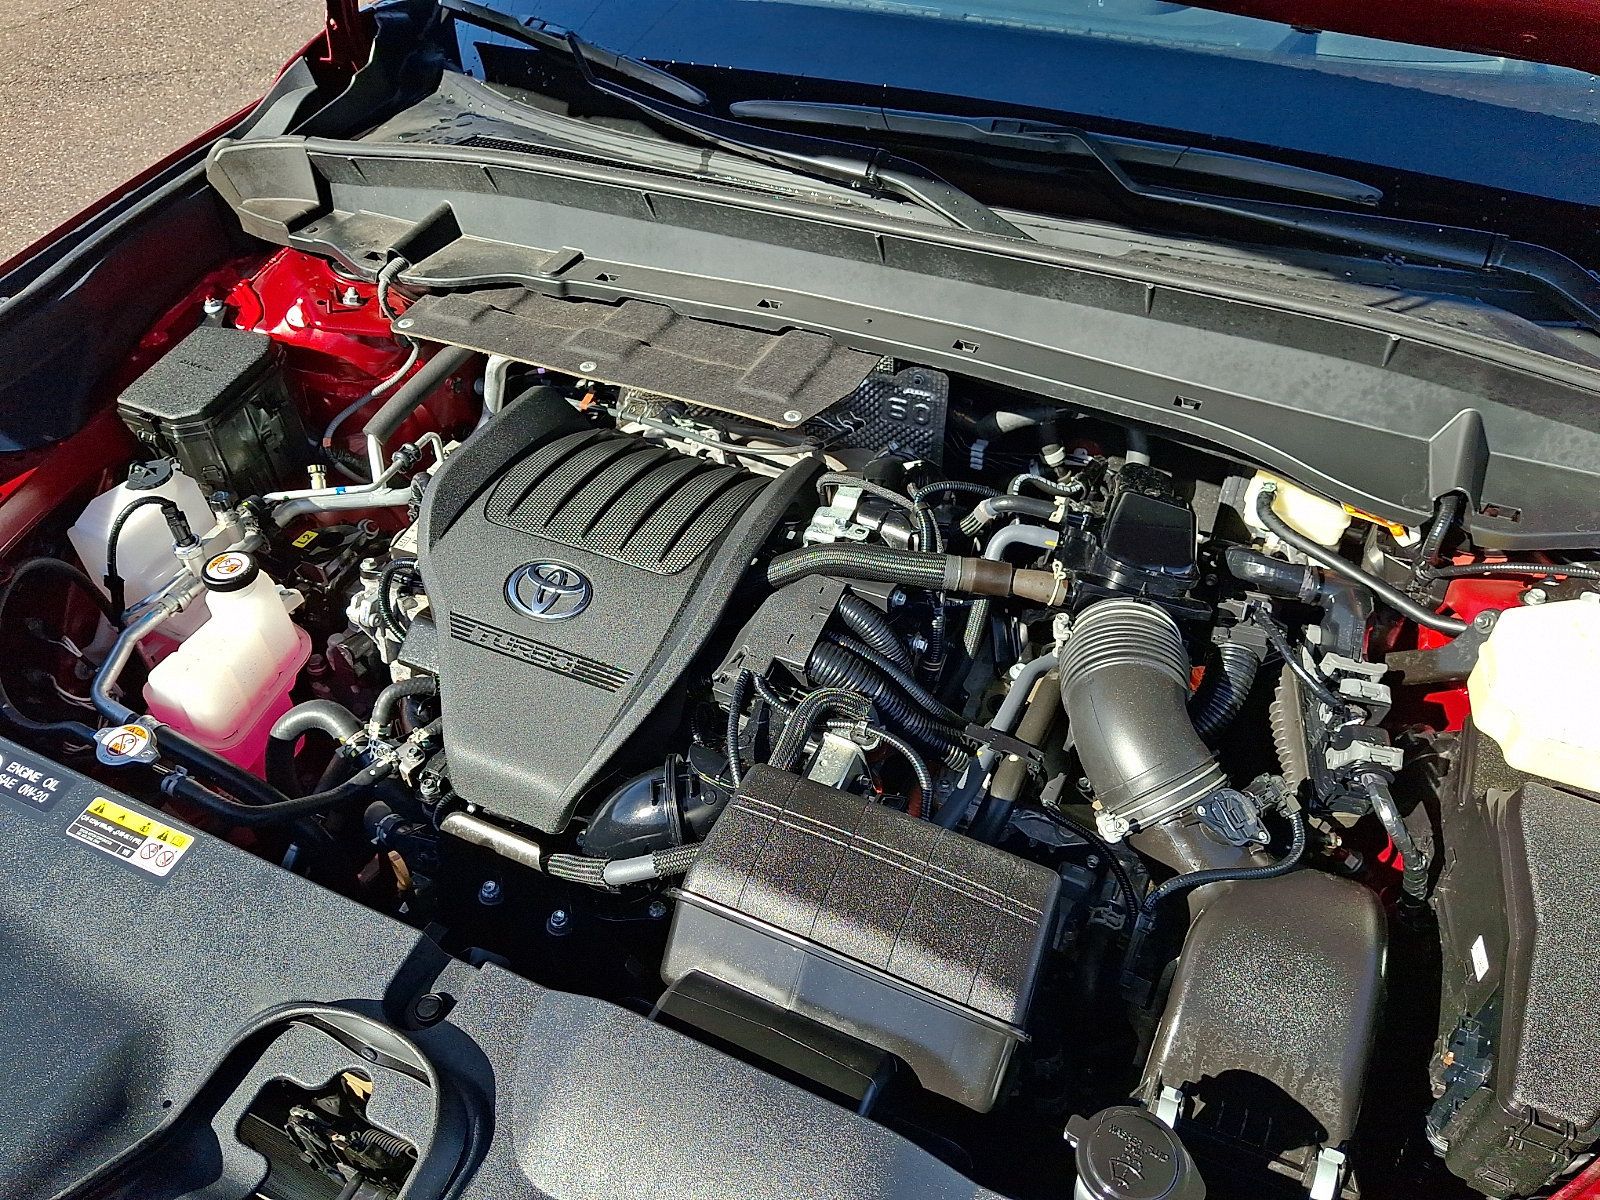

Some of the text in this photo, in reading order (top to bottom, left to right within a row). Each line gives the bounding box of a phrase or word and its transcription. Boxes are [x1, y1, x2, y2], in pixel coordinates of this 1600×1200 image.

[296, 534, 314, 544] L2
[474, 627, 575, 671] TURBO
[0, 773, 50, 803] SAE 0W-20
[5, 761, 60, 792] ENGINE OIL
